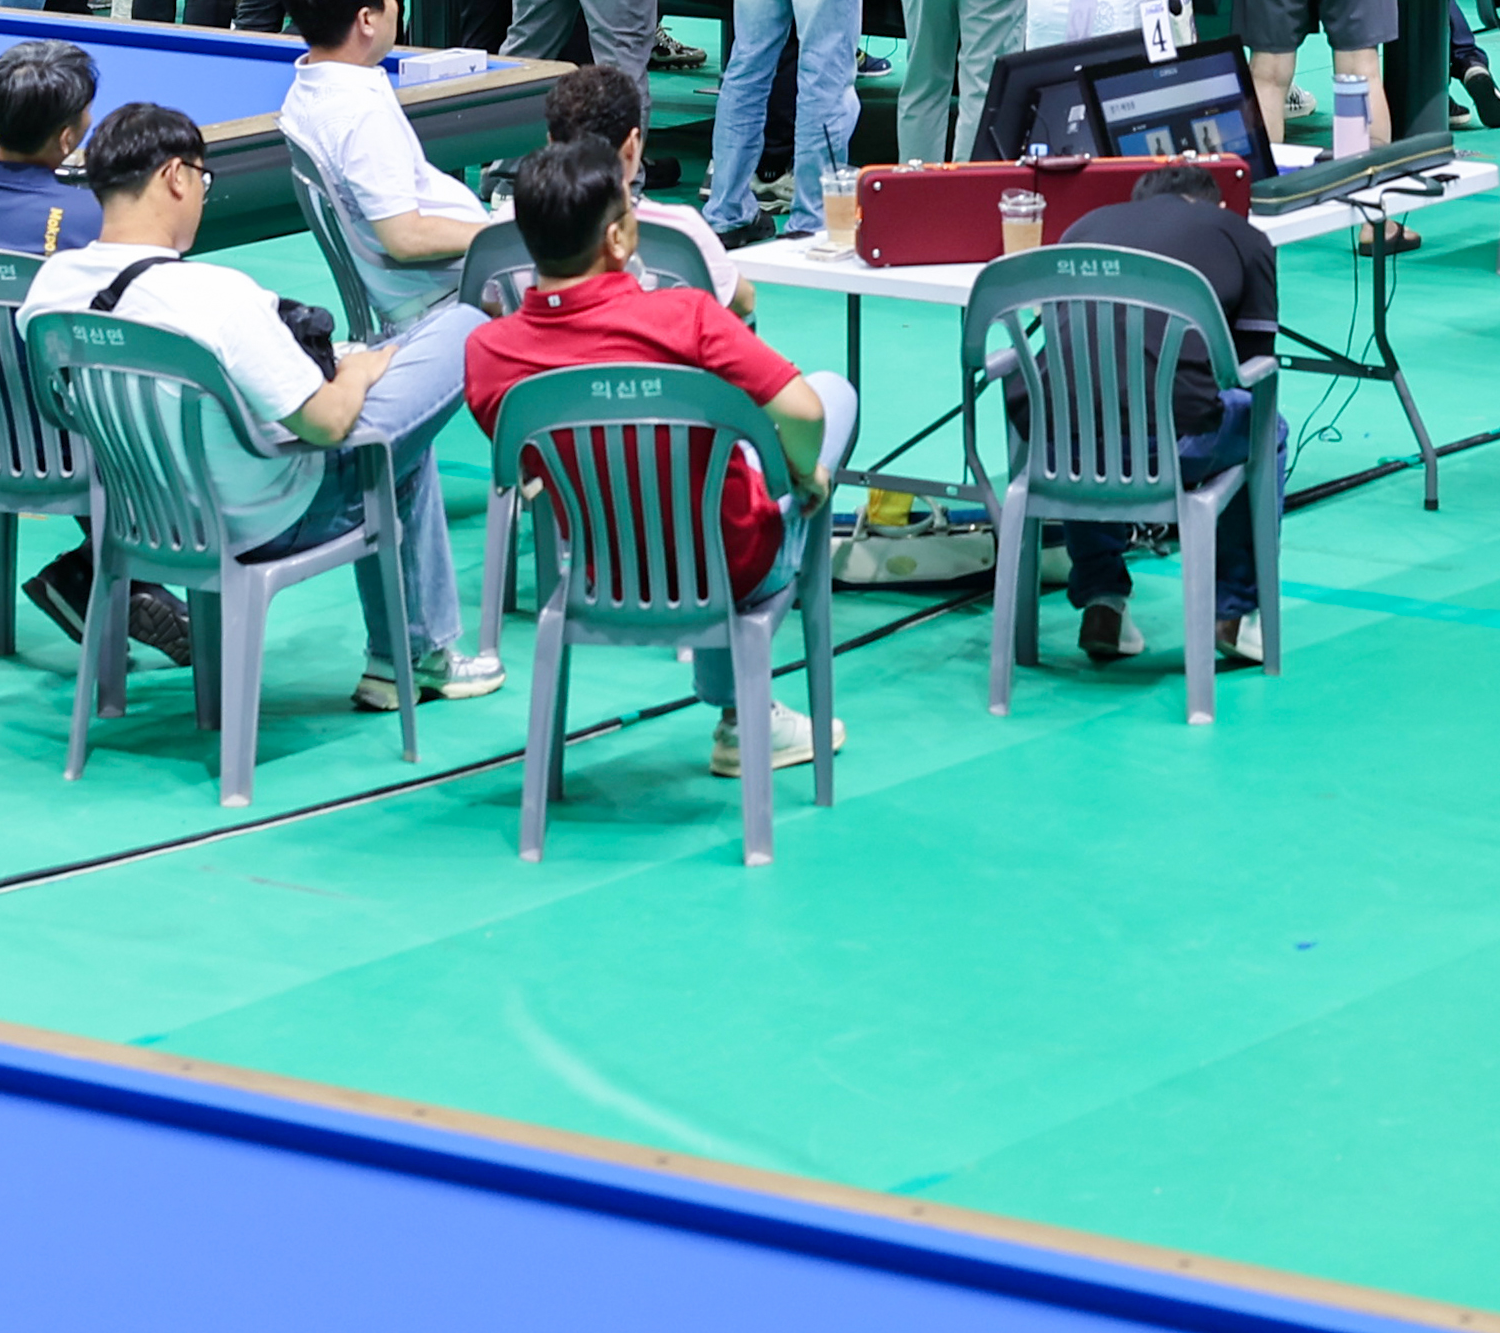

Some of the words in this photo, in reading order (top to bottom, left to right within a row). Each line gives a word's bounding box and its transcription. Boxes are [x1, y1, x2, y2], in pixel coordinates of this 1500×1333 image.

[1152, 18, 1168, 53] 4
[1056, 259, 1122, 277] 의신면
[72, 324, 126, 346] 의신면
[591, 377, 663, 400] 의신면
